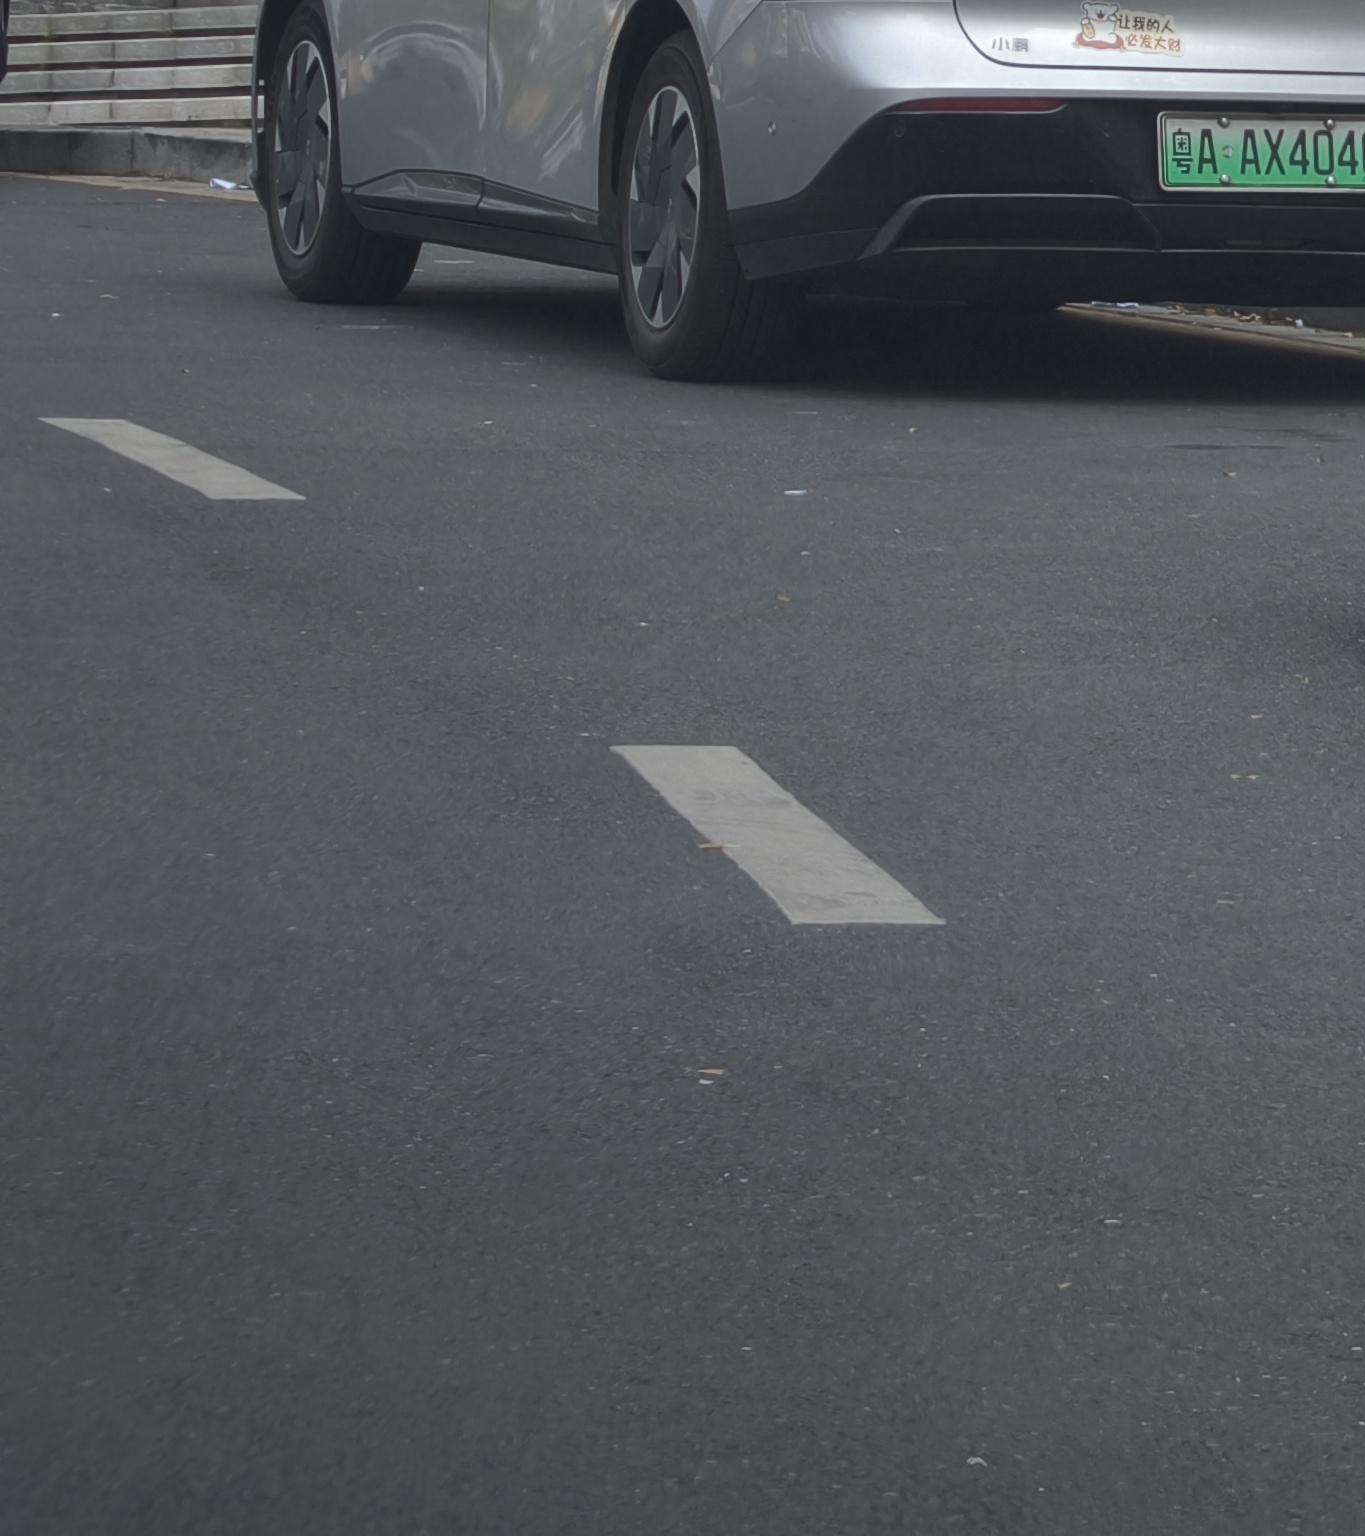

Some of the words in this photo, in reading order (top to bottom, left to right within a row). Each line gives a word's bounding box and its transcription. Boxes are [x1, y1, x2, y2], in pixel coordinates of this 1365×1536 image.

[1118, 14, 1174, 33] 让我的人
[1127, 34, 1181, 52] 必发大财
